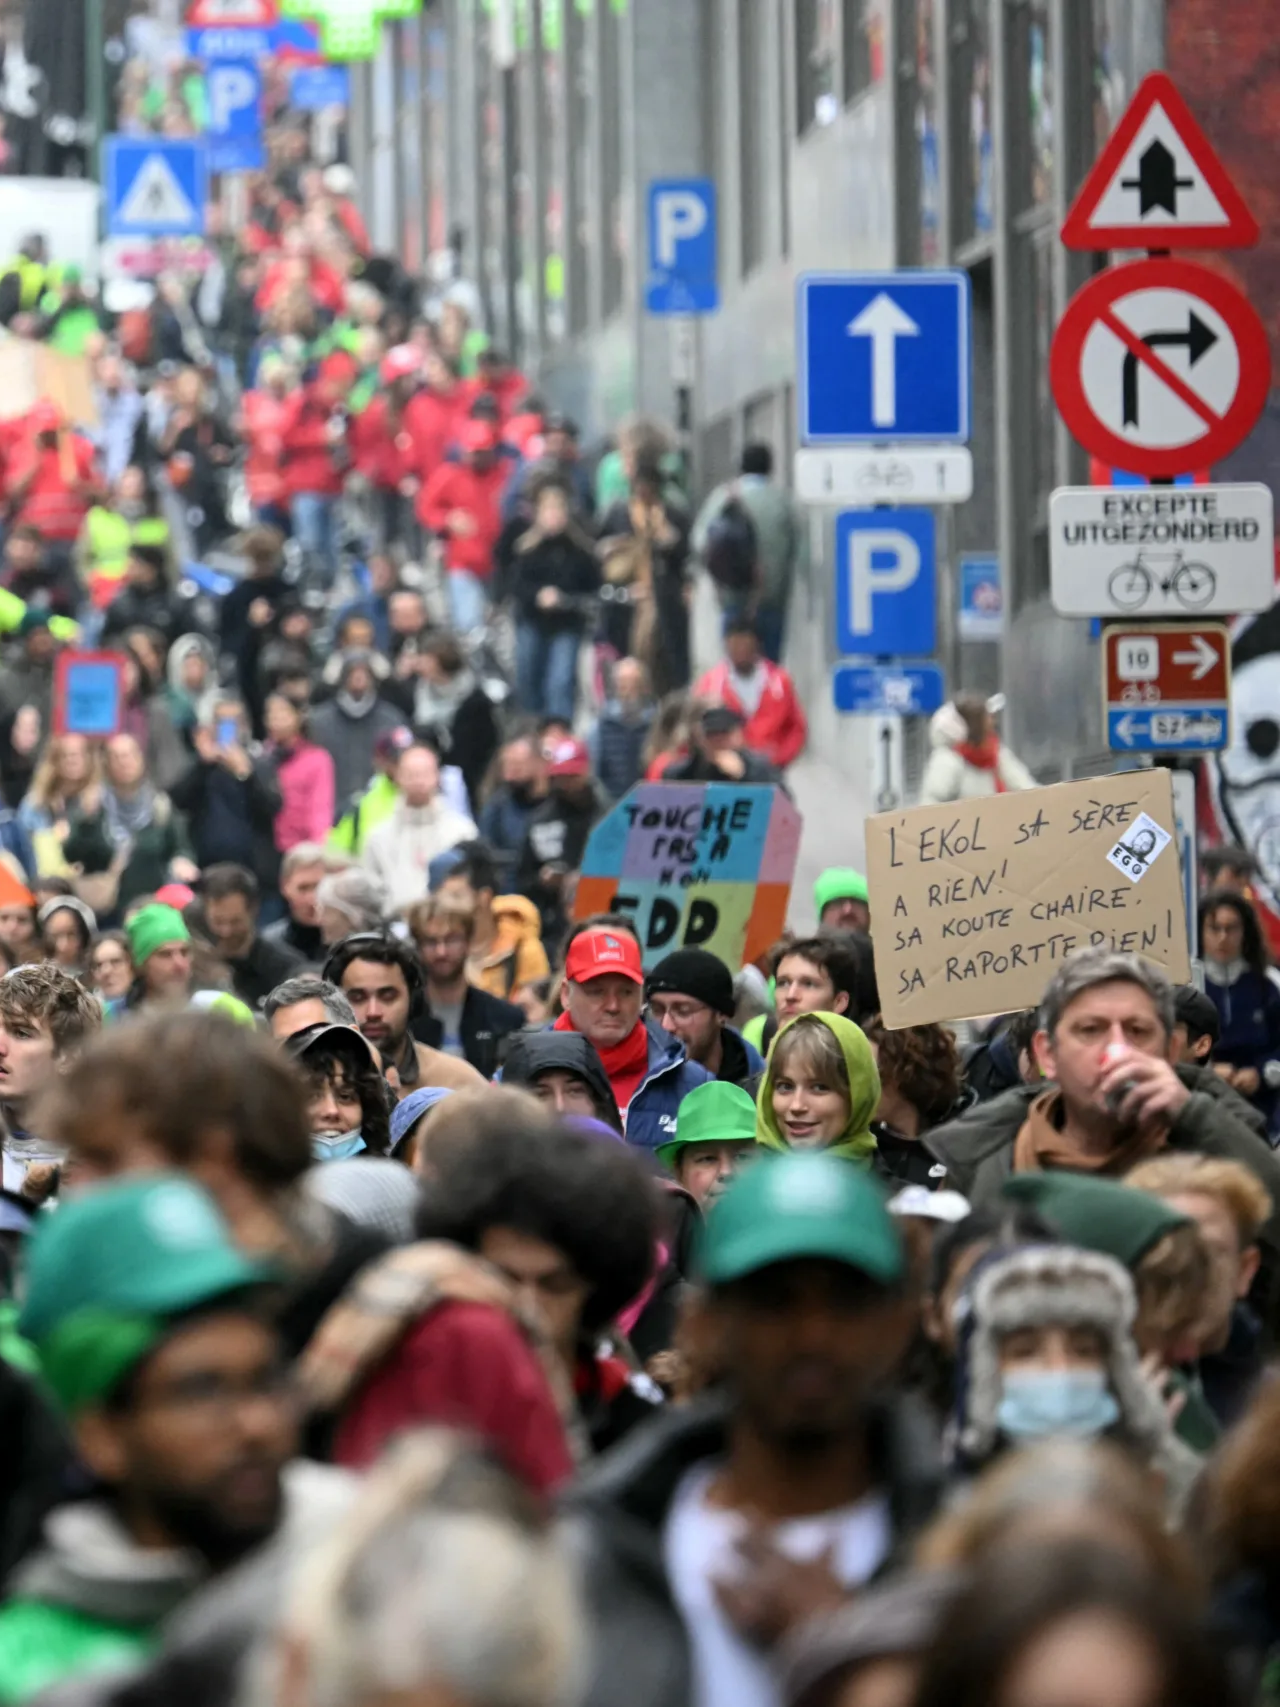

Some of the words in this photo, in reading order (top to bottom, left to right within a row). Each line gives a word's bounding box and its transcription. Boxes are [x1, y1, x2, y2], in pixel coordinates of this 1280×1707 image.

[656, 191, 708, 267] P
[1103, 494, 1218, 518] EXCEPTE
[1063, 518, 1260, 546] UITGEZONDERD
[849, 528, 921, 635] P
[625, 798, 753, 831] TOUCHE
[894, 895, 908, 917] A
[895, 927, 923, 951] SA
[942, 908, 1014, 938] KOUTE
[898, 968, 926, 994] SA
[946, 934, 1077, 982] RAPORTTE
